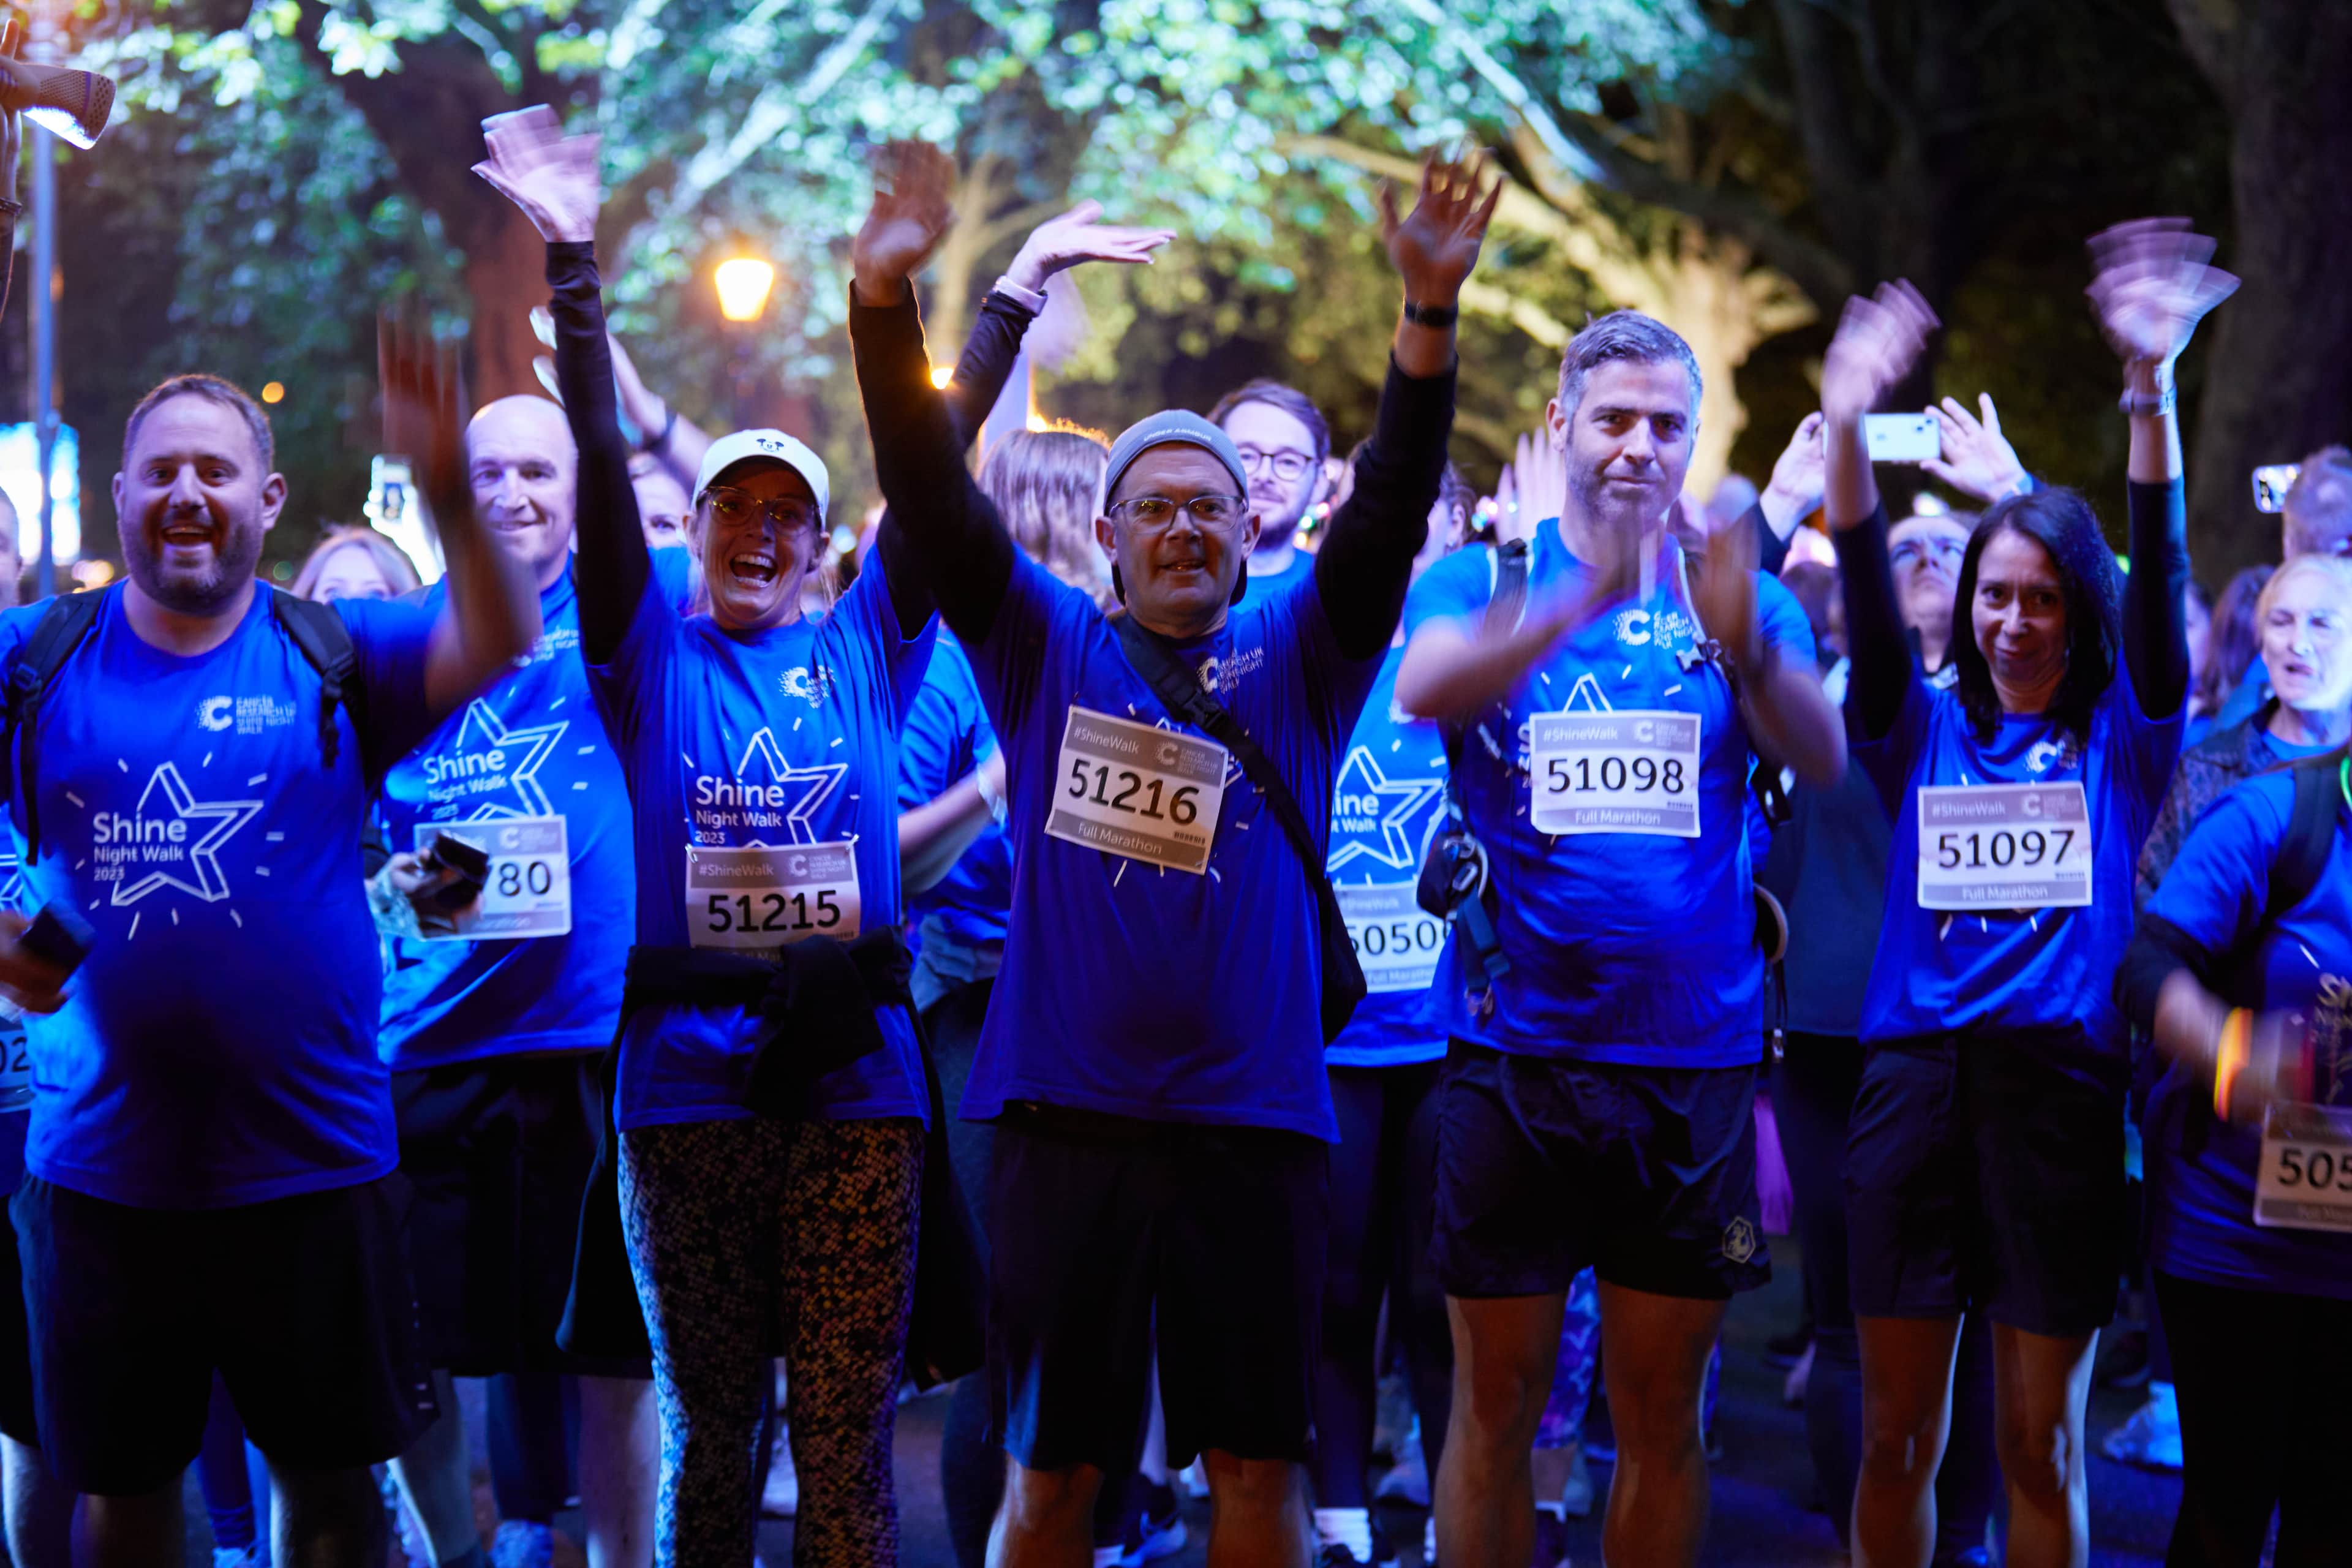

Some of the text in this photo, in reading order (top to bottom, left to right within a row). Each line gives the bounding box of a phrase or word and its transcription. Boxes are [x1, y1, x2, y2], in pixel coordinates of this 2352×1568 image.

[1174, 428, 1212, 442] ARMOUR
[1074, 725, 1139, 754] #ShineWalk
[1544, 726, 1618, 742] #ShineWalk
[423, 749, 506, 784] Shine
[1548, 756, 1684, 794] 51098
[467, 774, 508, 794] Walk
[696, 775, 785, 807] Shine
[1069, 758, 1200, 826] 51216
[1332, 788, 1380, 816] ine
[1932, 801, 2006, 818] #ShineWalk
[93, 812, 187, 843] Shine
[696, 809, 782, 829] Night Walk
[1341, 816, 1378, 834] Walk
[1575, 810, 1660, 825] Full Marathon
[695, 831, 726, 844] 2023
[1078, 823, 1162, 855] Full Marathon
[94, 845, 184, 866] Night Walk
[1938, 829, 2075, 869] 51097
[94, 865, 125, 881] 2023
[699, 862, 774, 877] #ShineWalk
[1961, 885, 2048, 900] Full Marathon
[708, 889, 841, 933] 51215
